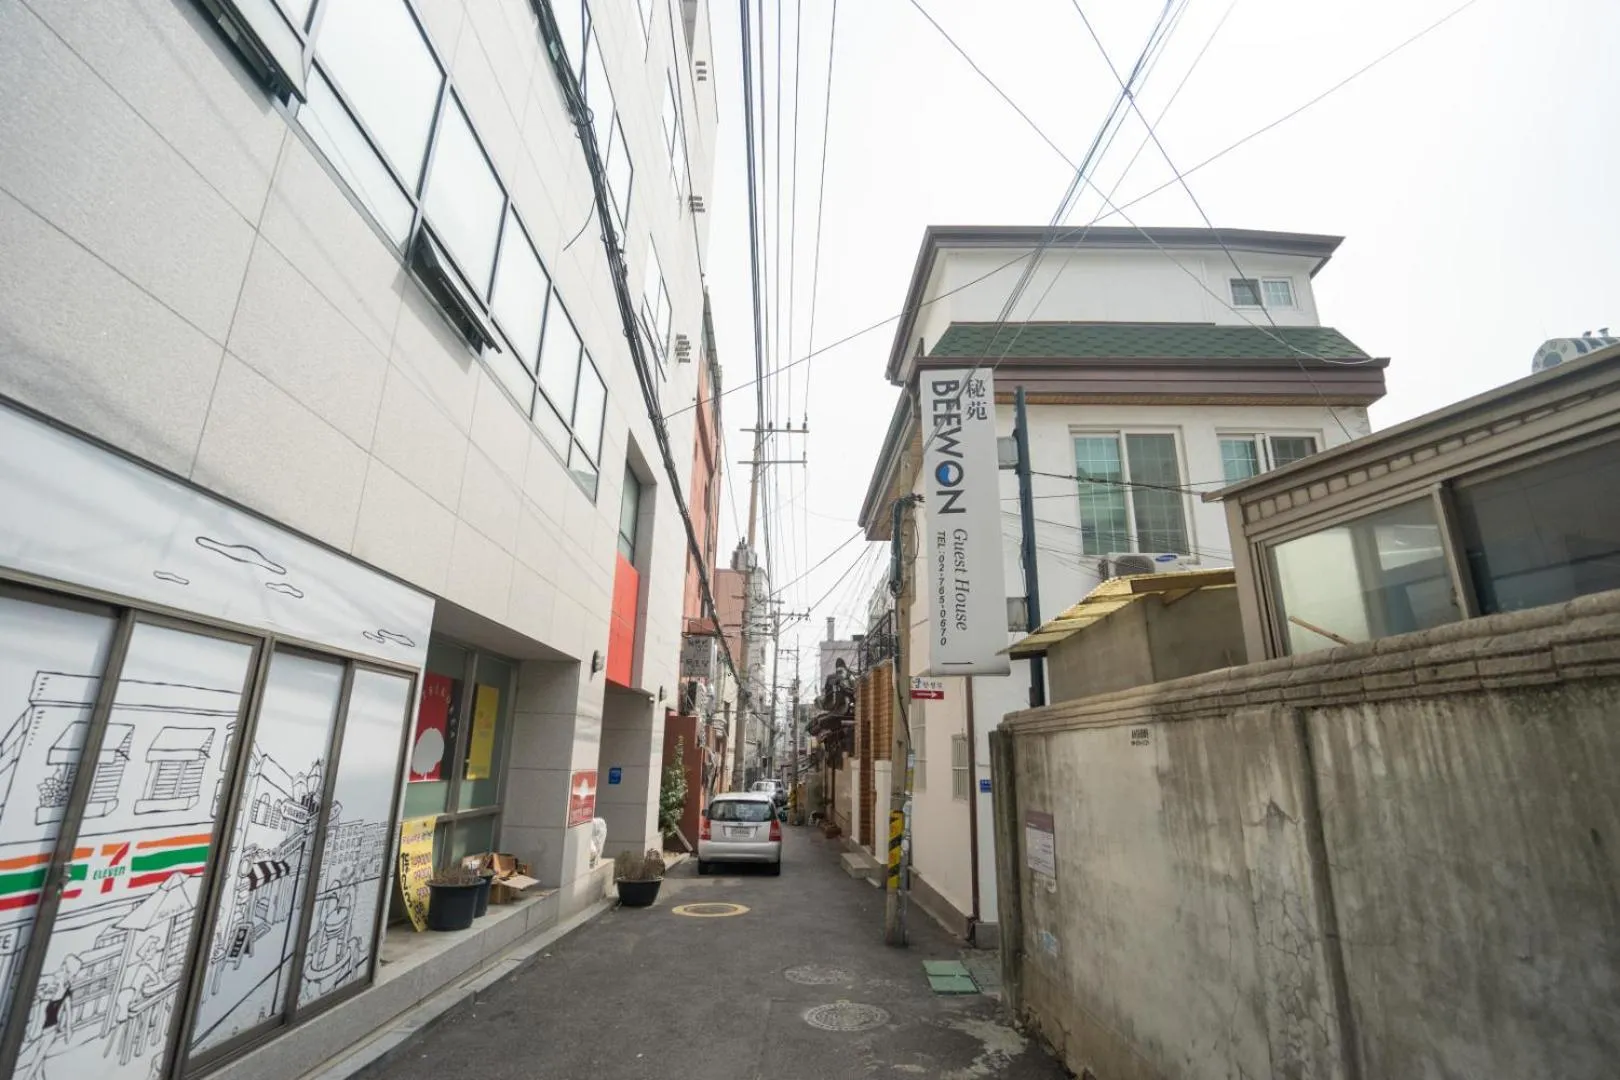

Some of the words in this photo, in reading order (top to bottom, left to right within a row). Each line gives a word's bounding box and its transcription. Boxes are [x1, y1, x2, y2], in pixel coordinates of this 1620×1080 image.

[965, 379, 988, 421] 秘苑
[931, 379, 967, 515] BEEWON
[952, 528, 969, 574] Guest
[954, 577, 971, 632] House
